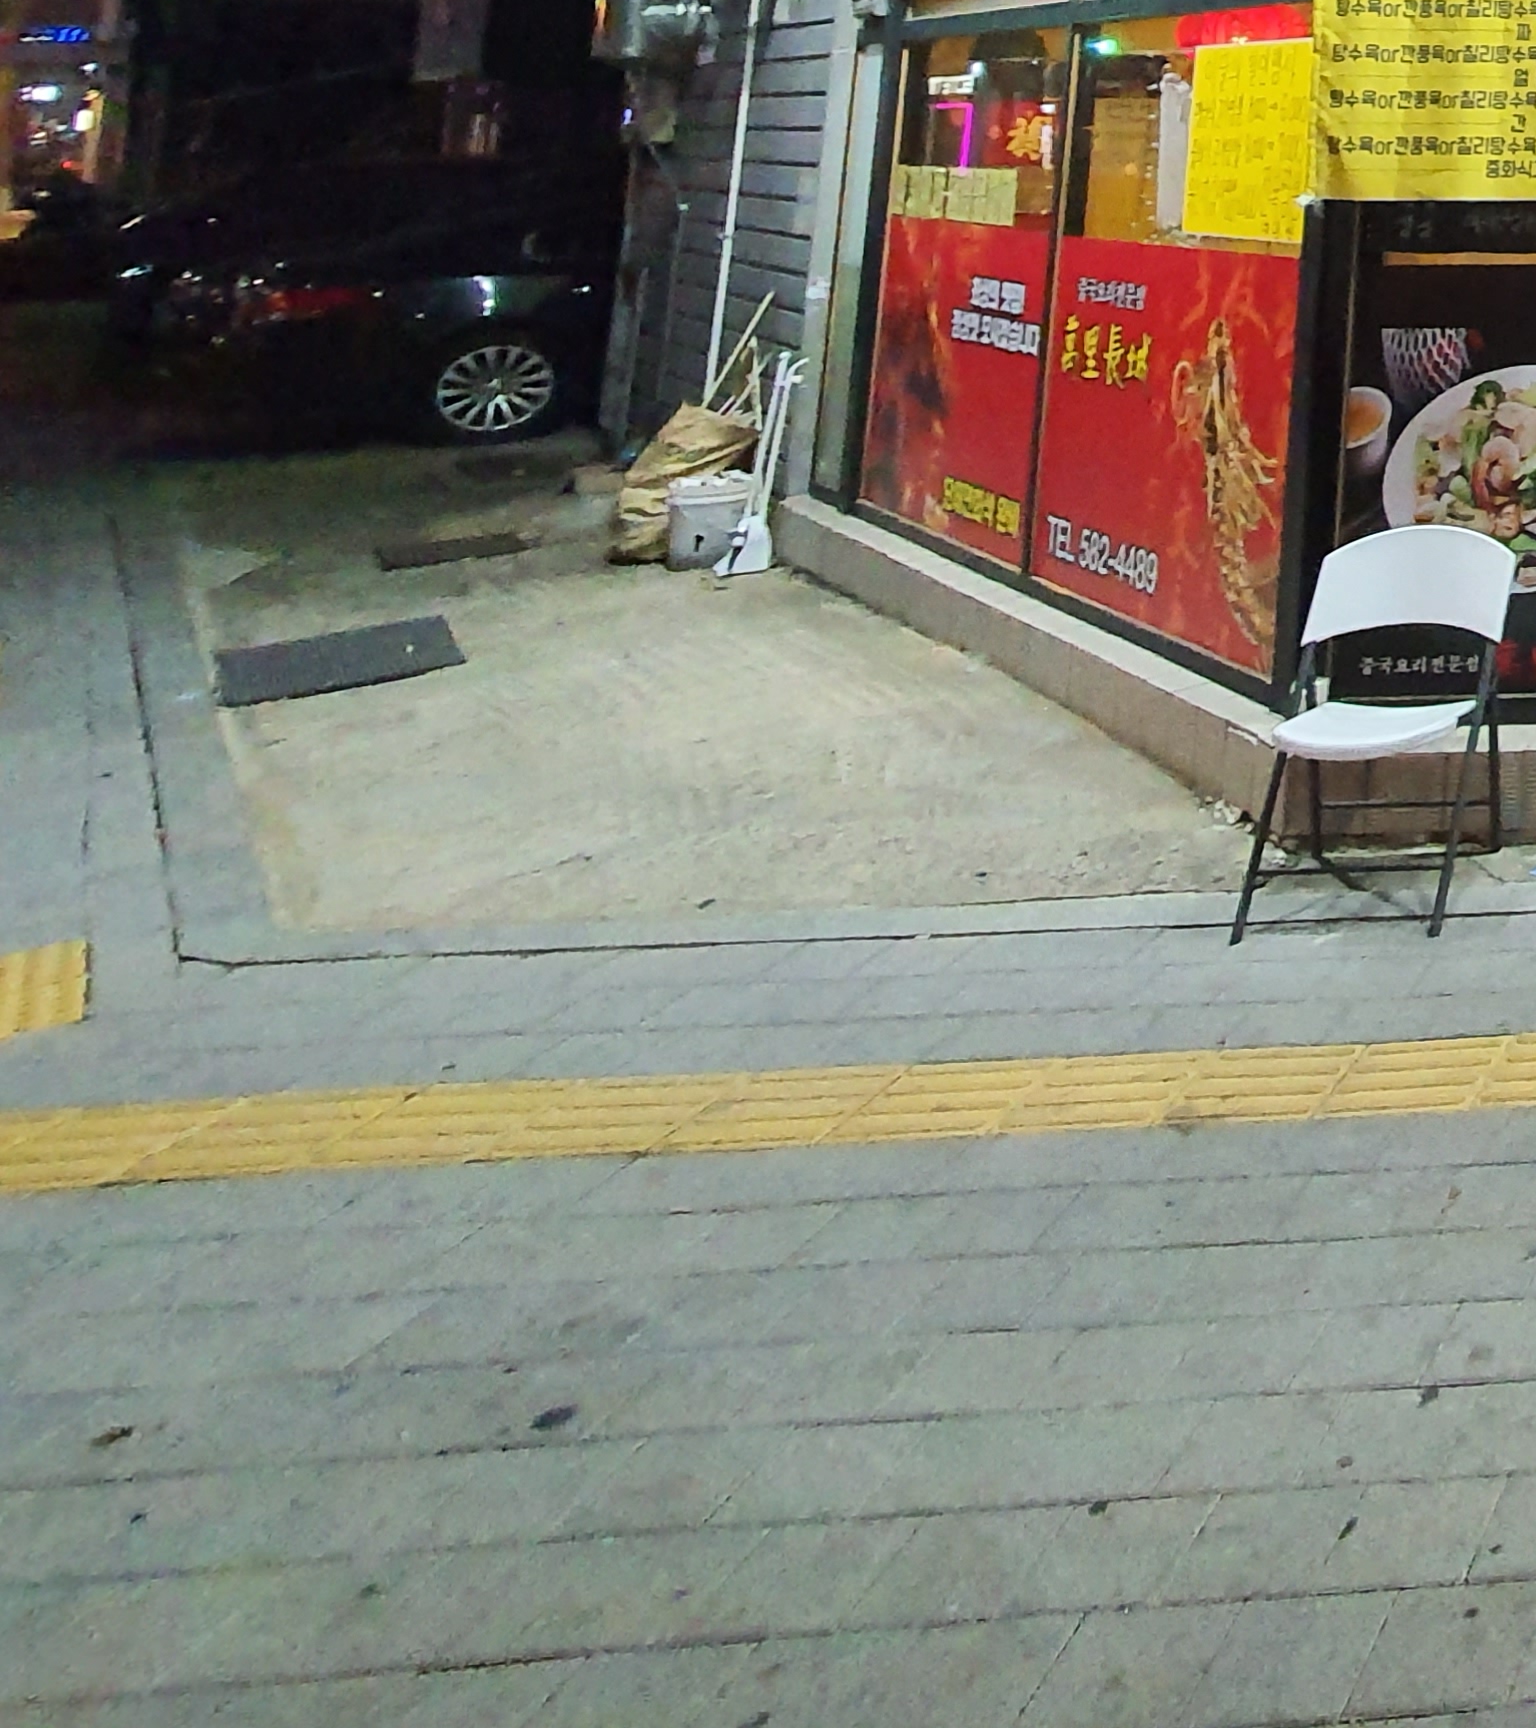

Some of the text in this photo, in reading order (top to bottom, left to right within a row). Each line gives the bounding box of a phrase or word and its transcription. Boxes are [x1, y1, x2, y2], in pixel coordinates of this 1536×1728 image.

[1047, 514, 1159, 595] TEL 582-4489
[1358, 654, 1479, 675] 중국요리전문점
